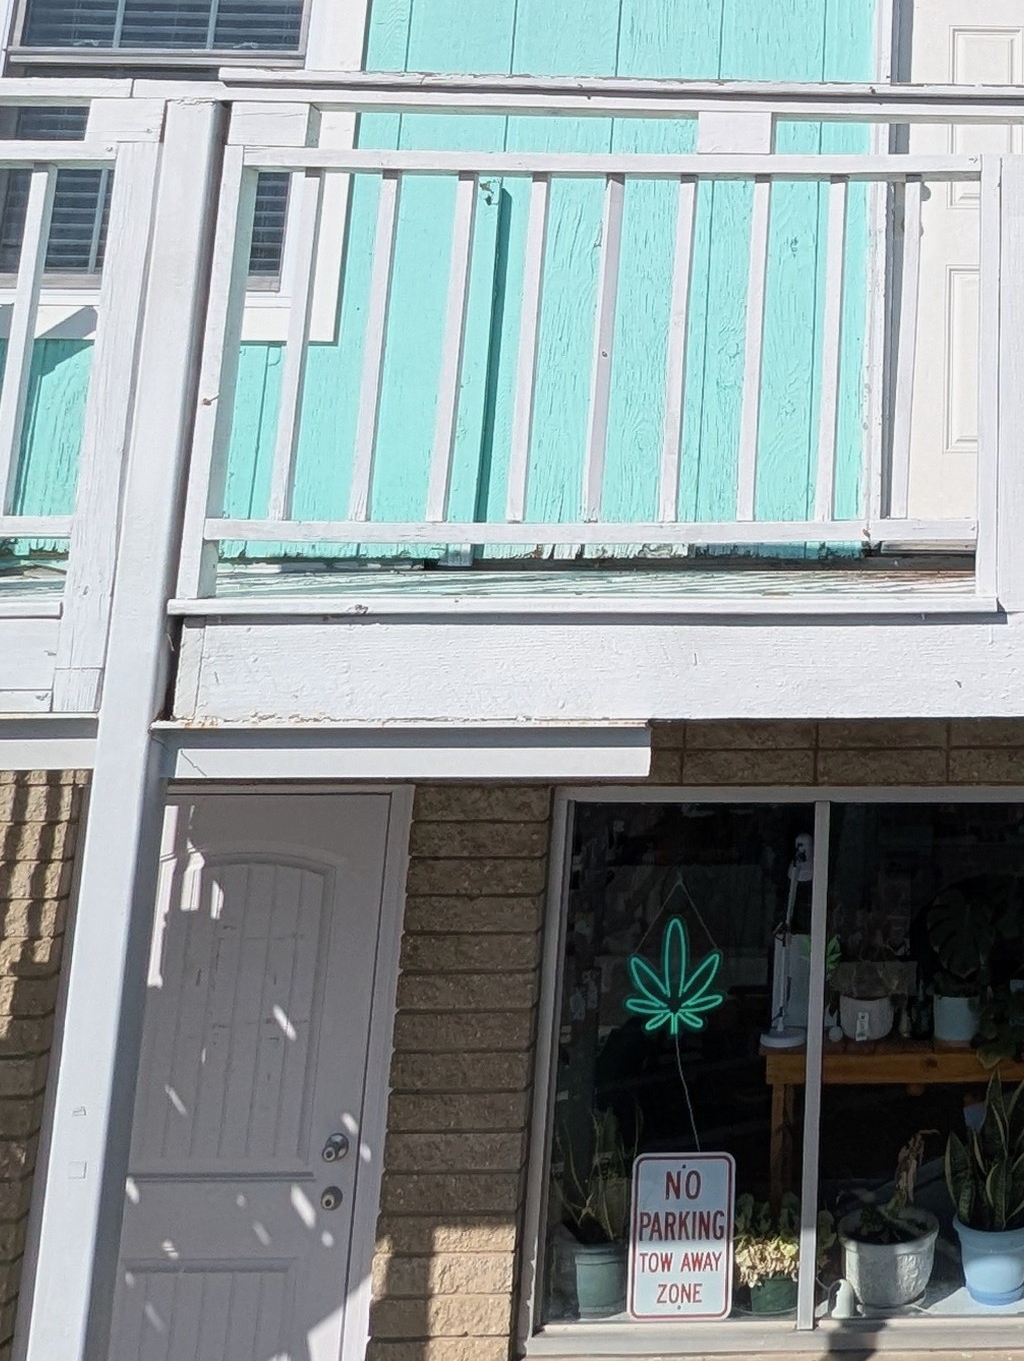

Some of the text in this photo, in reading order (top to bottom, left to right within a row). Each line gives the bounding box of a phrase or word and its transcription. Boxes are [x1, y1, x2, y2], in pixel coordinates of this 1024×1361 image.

[665, 1170, 701, 1200] NO
[639, 1210, 725, 1242] PARKING
[639, 1251, 723, 1273] TOW AWAY
[656, 1283, 703, 1304] ZONE
